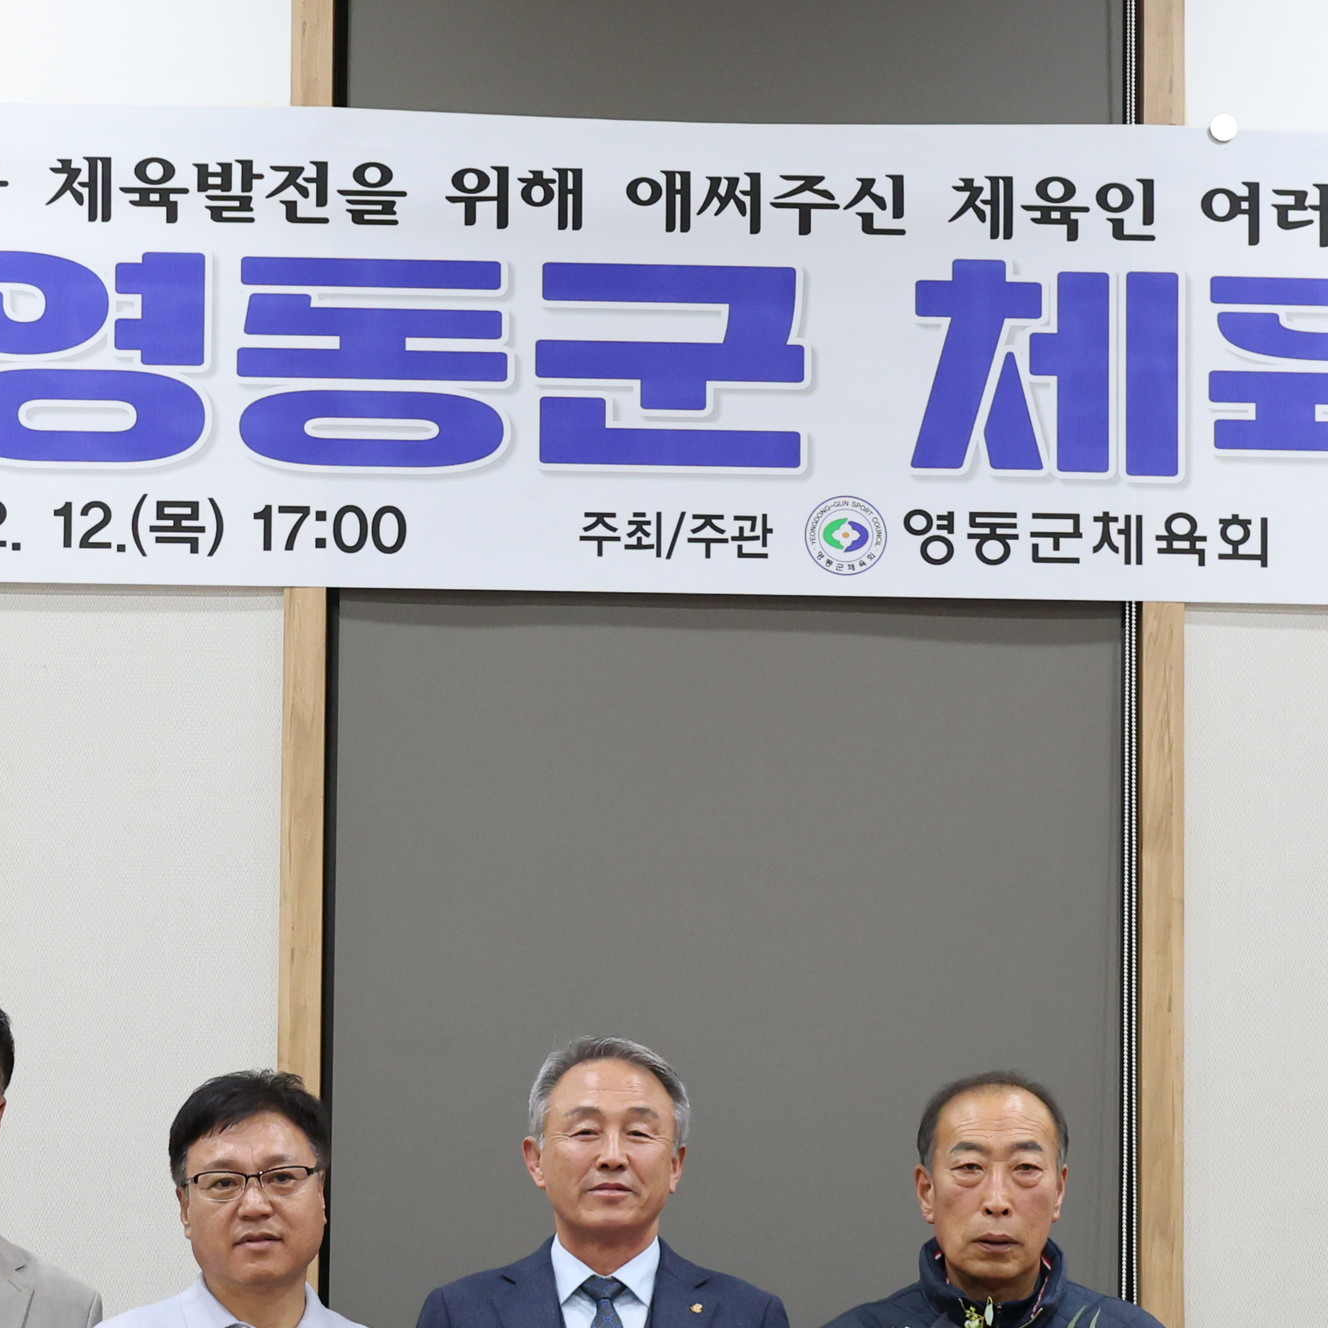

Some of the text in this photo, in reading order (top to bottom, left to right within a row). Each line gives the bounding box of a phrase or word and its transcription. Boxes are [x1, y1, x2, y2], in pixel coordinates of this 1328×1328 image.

[45, 156, 408, 226] 체육발전을
[444, 165, 583, 231] 위해
[625, 169, 907, 236] 애써주신
[947, 175, 1156, 242] 체육인
[253, 504, 407, 555] 17:00
[579, 508, 1268, 568] 주최/주관 영동군체육회
[851, 501, 874, 517] SPORT
[872, 516, 883, 547] COUNCIL
